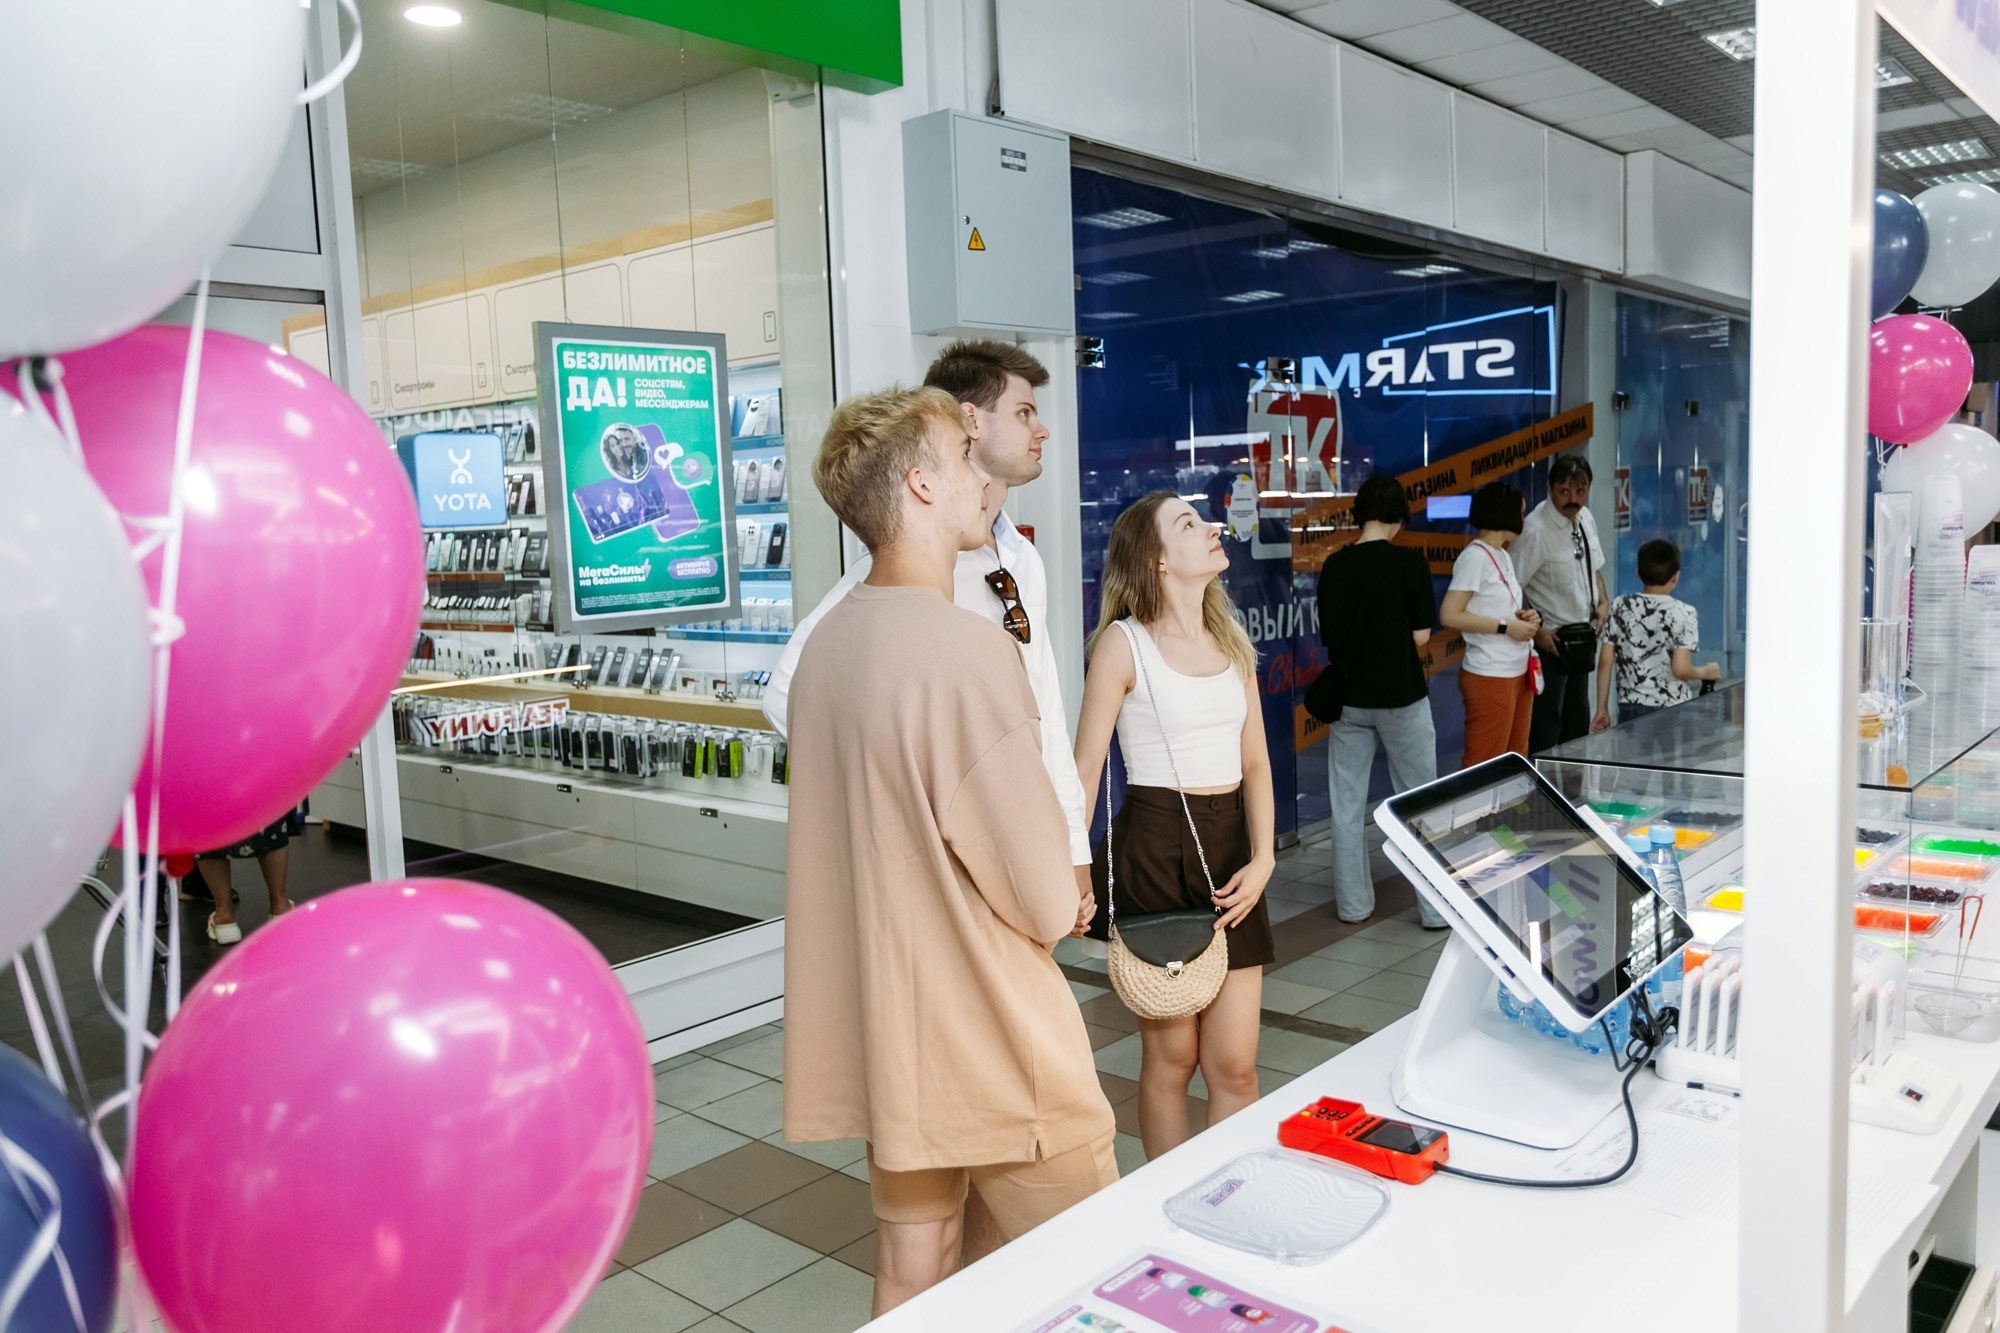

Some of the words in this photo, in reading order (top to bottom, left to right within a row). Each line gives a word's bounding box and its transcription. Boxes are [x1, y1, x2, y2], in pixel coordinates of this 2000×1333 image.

[562, 350, 707, 374] БЕЗЛИМИТНОЕ
[634, 378, 686, 390] СОЦСЕТЯМ,
[566, 375, 628, 412] ДА!
[634, 388, 667, 399] ВИДЕО,
[635, 399, 709, 410] МЕССЕНДЖЕРАМ
[1405, 468, 1457, 502] АГАЗИНА
[1470, 434, 1540, 479] ЛИКВИДАЦИЯ
[1540, 415, 1587, 449] МАГАЗИНА
[433, 493, 492, 511] YOTA
[676, 560, 711, 569] АКТИВИРУЙ
[578, 564, 646, 579] МегаСилы
[676, 567, 711, 577] БЕСПЛАТНО
[579, 578, 591, 587] на
[592, 574, 646, 586] безлимиты
